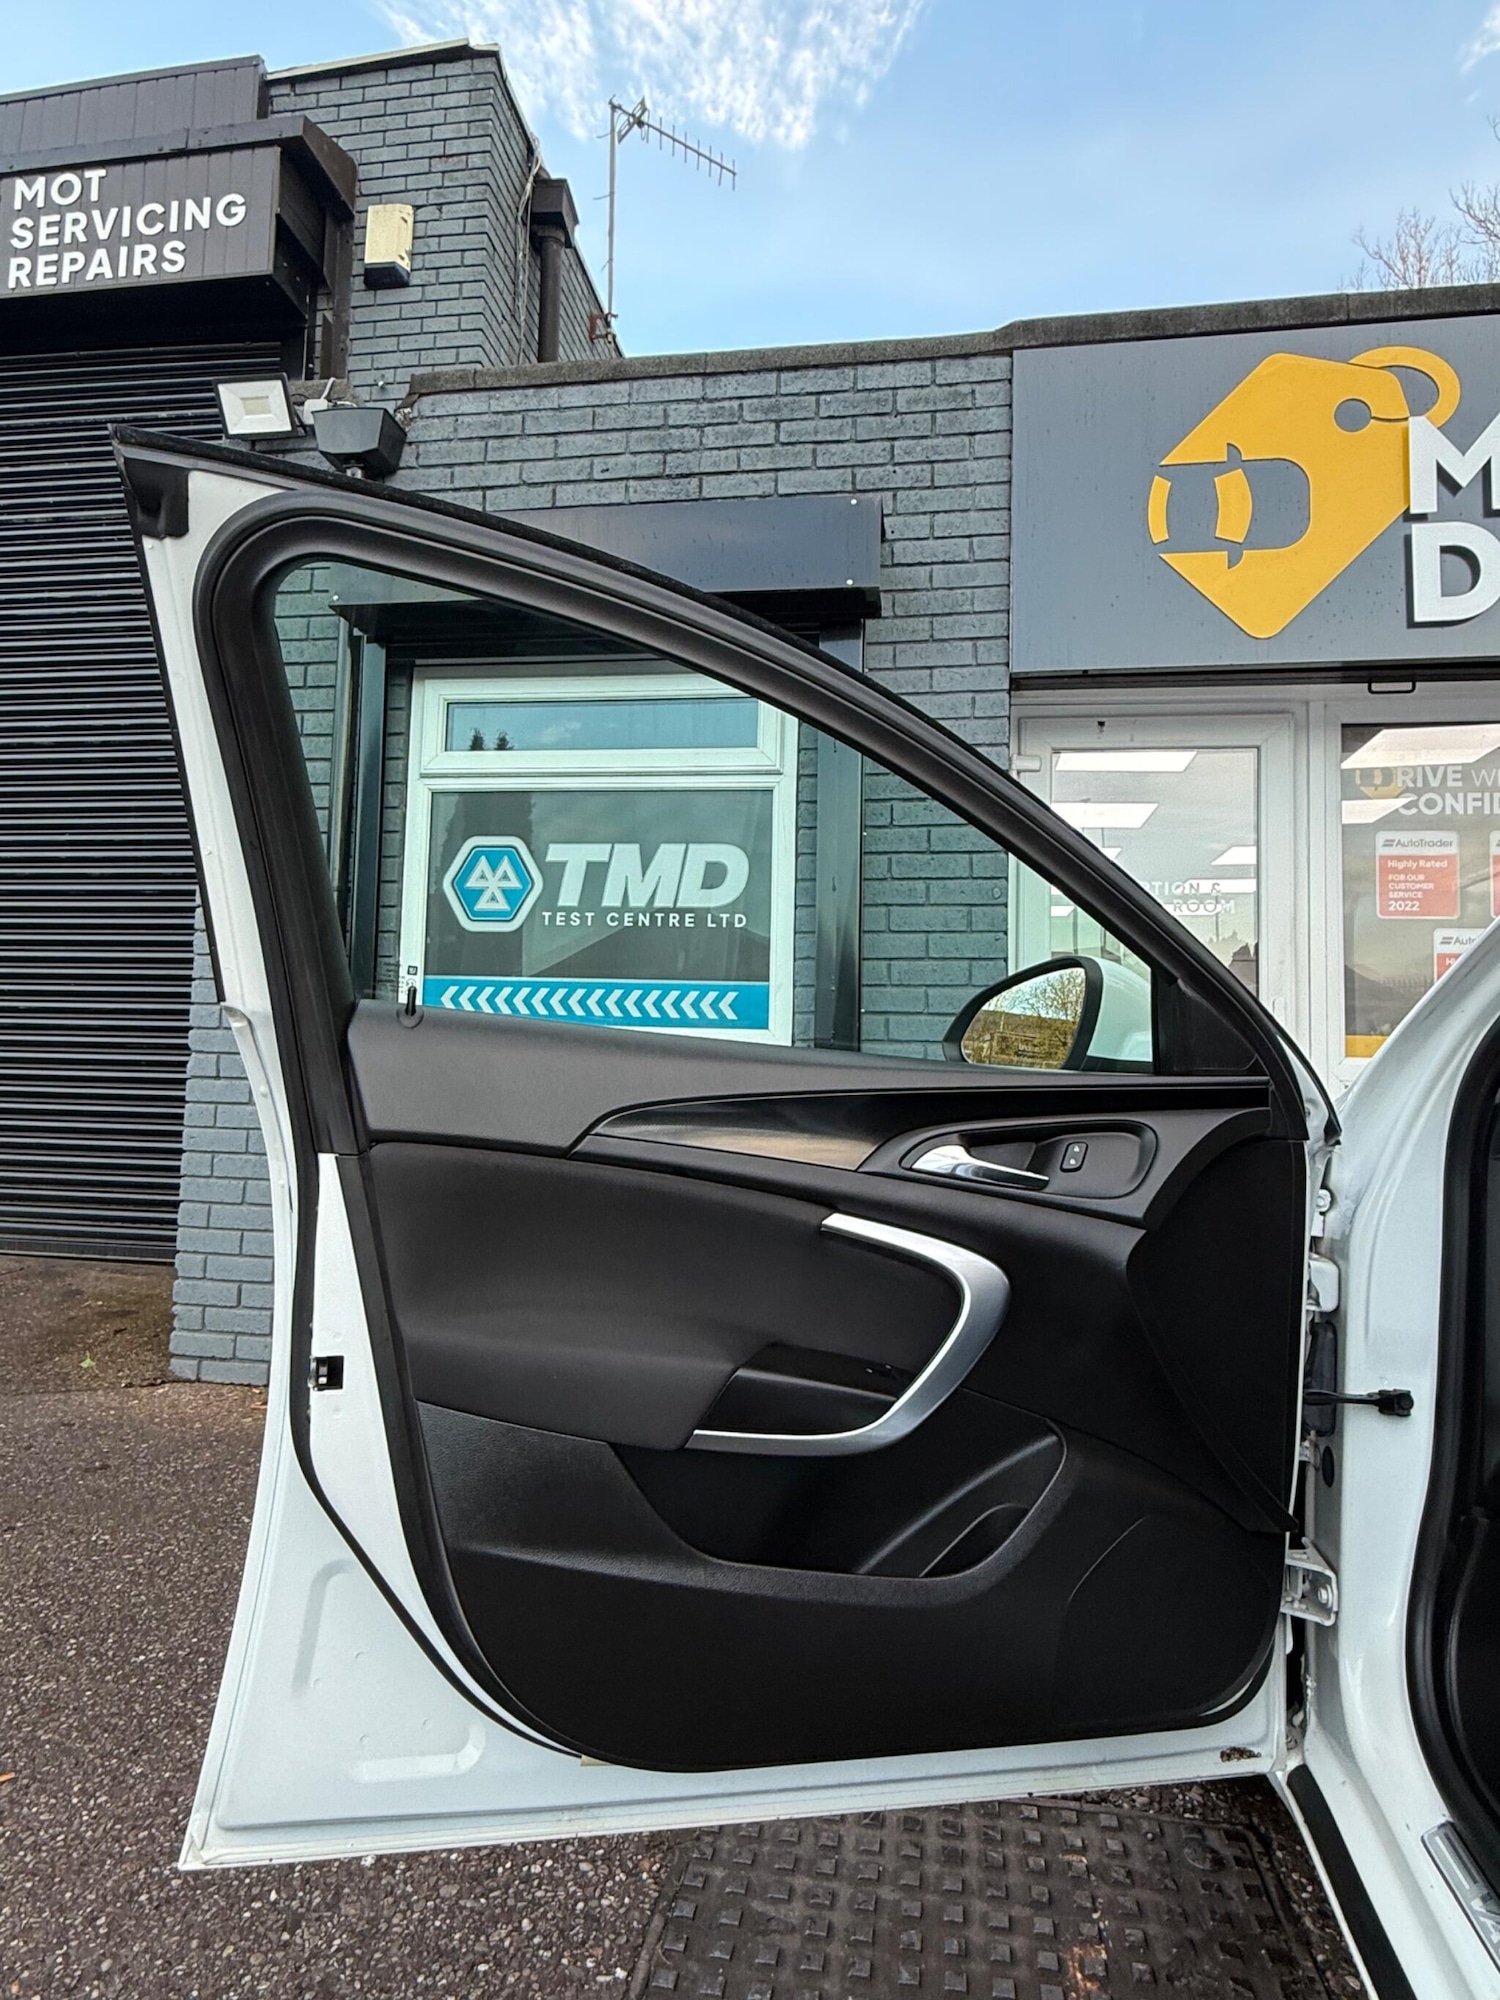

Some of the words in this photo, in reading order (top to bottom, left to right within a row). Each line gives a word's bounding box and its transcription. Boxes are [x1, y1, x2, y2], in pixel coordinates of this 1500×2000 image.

[14, 169, 106, 211] MOT
[10, 193, 247, 249] SERVICING
[8, 240, 187, 289] REPAIRS
[1395, 838, 1454, 849] AutoTrader
[1387, 859, 1418, 870] Highly
[1419, 859, 1448, 868] Rated
[545, 843, 750, 909] TMD
[1388, 873, 1406, 881] FOR
[1406, 873, 1425, 881] OUR
[1388, 882, 1434, 890] CUSTOMER
[1388, 891, 1423, 899] SERVICE
[1173, 899, 1235, 914] ROOM
[1388, 900, 1420, 911] 2022
[542, 911, 595, 927] TEST
[606, 912, 696, 928] CENTRE
[707, 913, 748, 928] LTD
